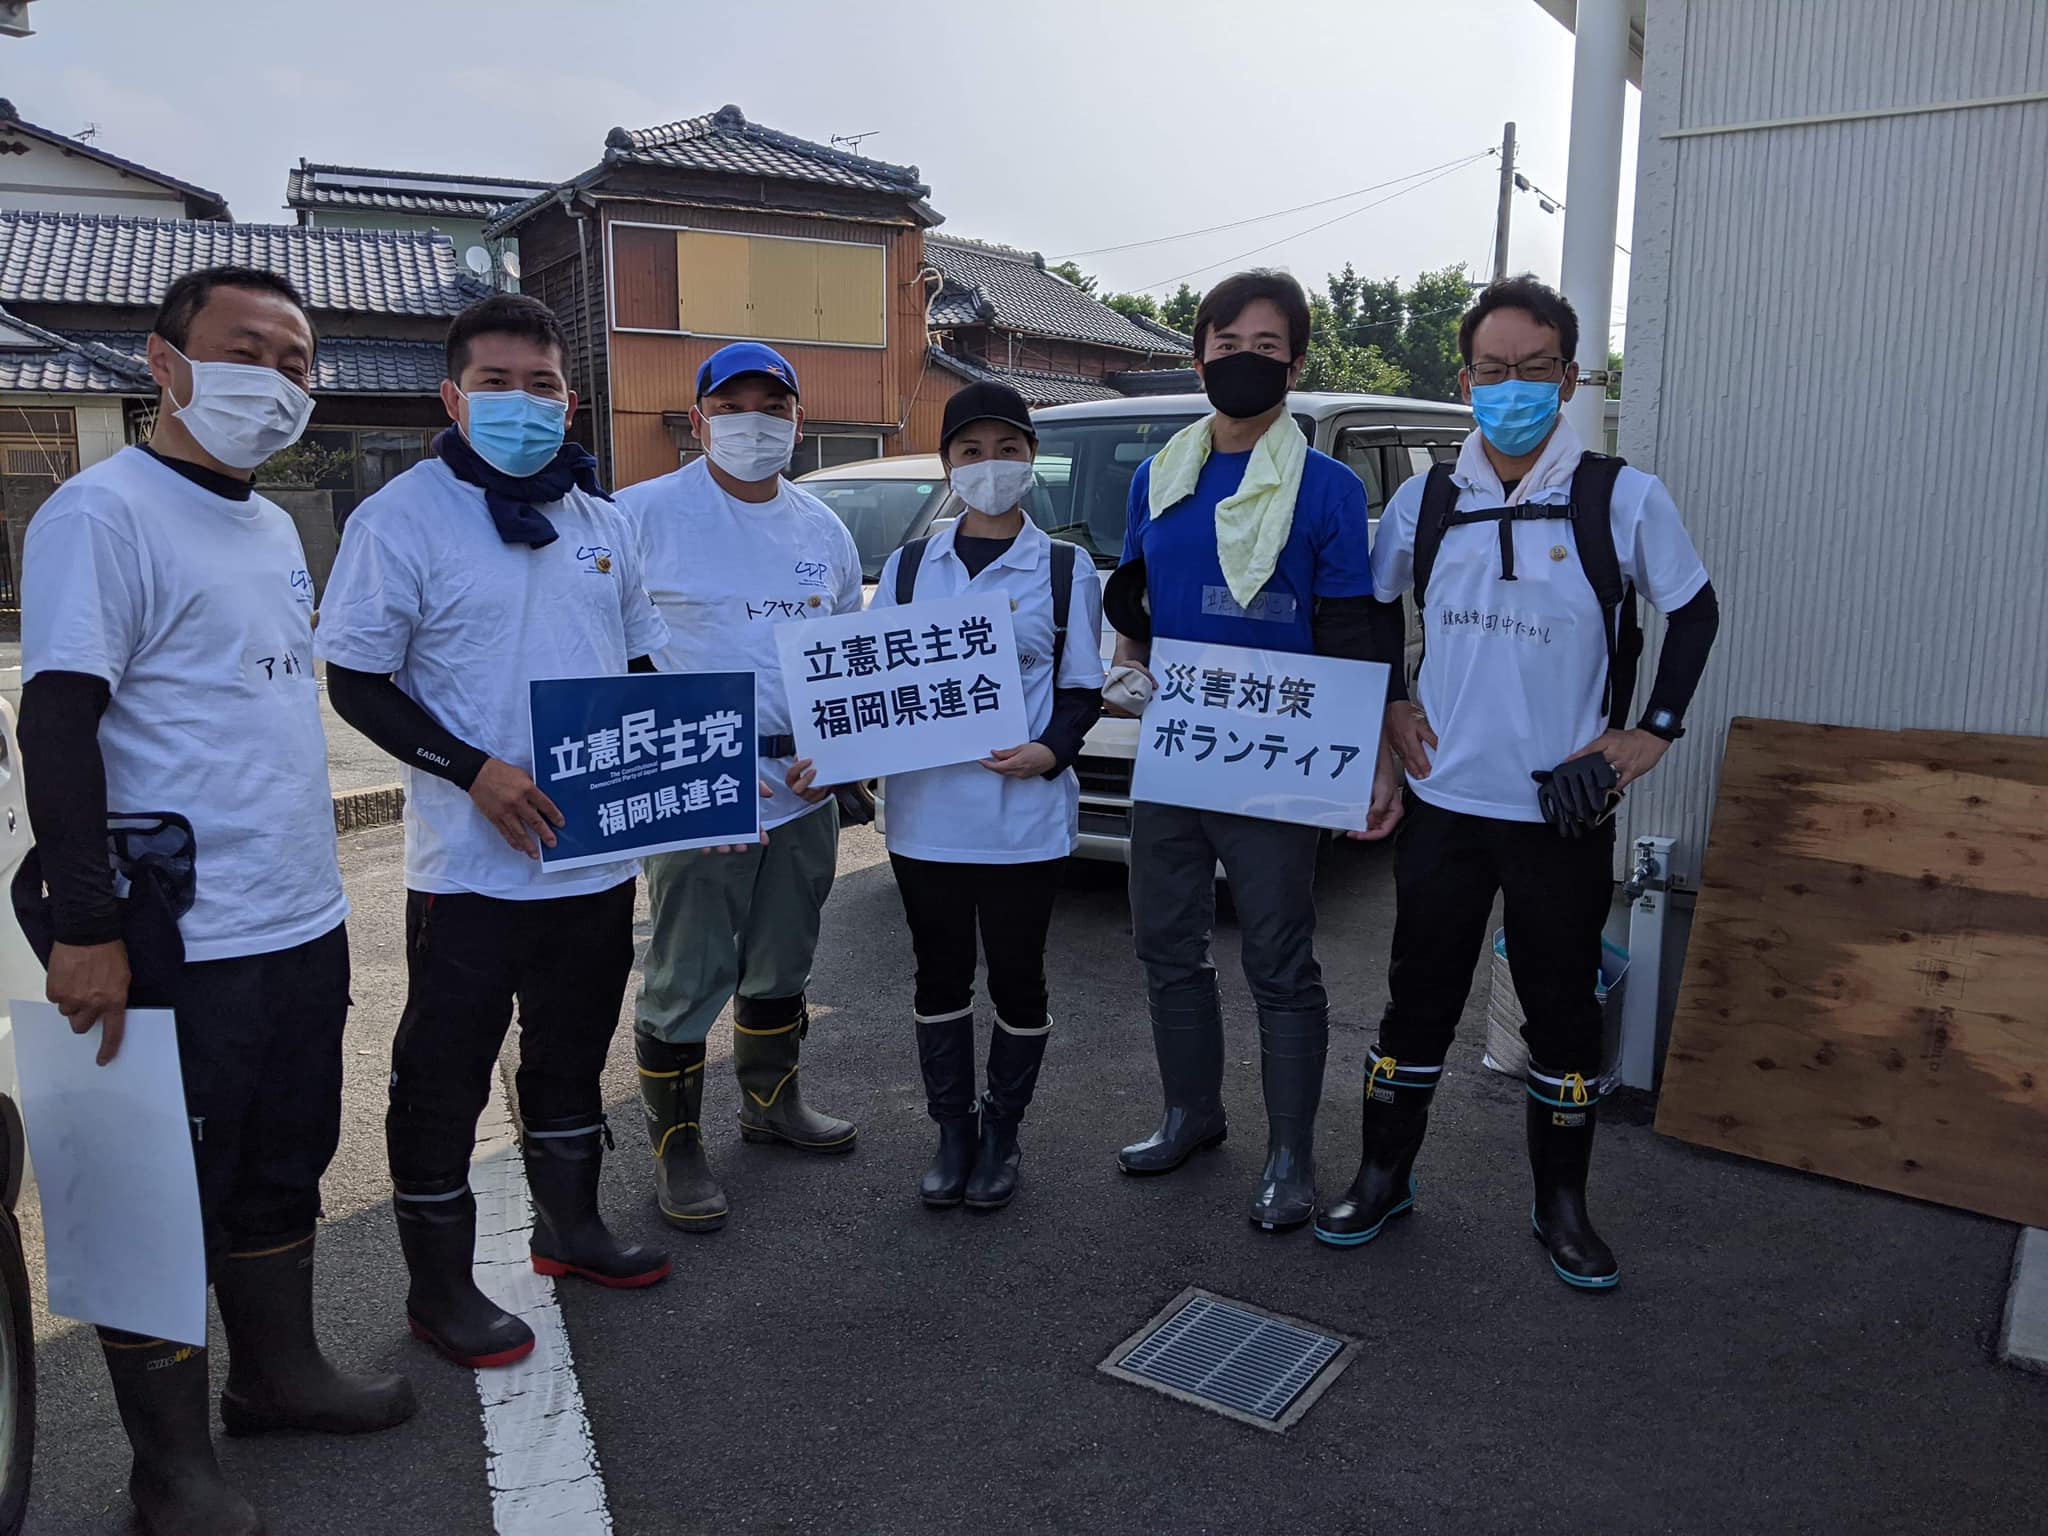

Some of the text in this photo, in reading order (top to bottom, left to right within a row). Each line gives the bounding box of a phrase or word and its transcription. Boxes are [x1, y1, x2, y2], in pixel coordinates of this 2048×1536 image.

[795, 561, 827, 580] CDP
[746, 600, 807, 620] トクヤス
[803, 616, 997, 682] 立憲民主党
[812, 673, 1001, 740] 福岡県連合
[1161, 663, 1316, 719] 災害対策
[416, 747, 451, 767] EADALI
[551, 709, 743, 781] 立憲民主党
[1153, 718, 1361, 779] ボランティア
[590, 777, 621, 790] Democratic
[622, 773, 637, 781] Party
[598, 773, 740, 837] 福岡県連合
